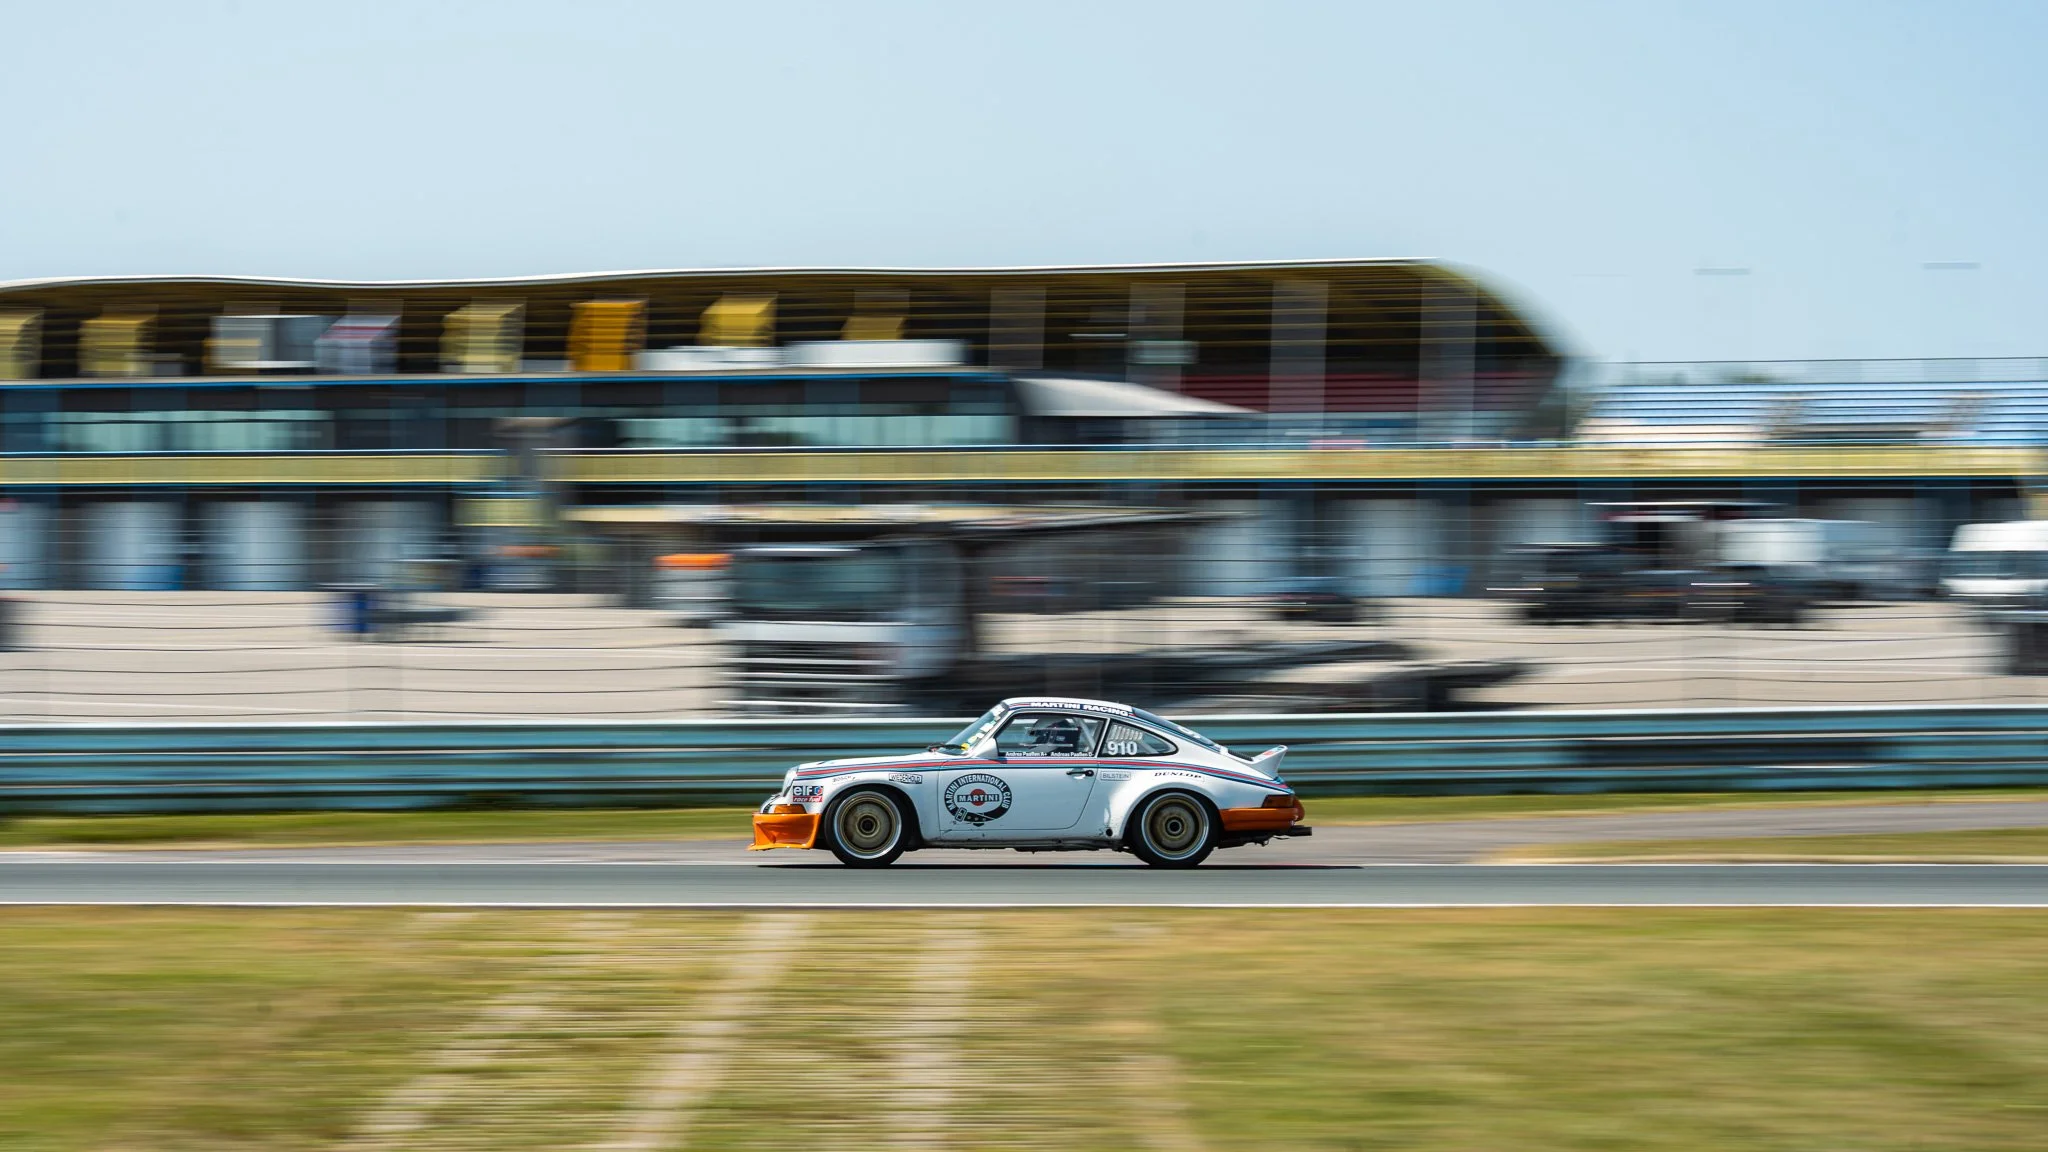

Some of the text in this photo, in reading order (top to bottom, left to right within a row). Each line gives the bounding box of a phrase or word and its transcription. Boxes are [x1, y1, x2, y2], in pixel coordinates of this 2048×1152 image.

[1083, 704, 1129, 716] RACING
[1107, 741, 1137, 755] 910
[1154, 771, 1202, 779] DUNLOP
[945, 774, 1011, 811] MARTINI INTERNATIONAL CLUB
[959, 794, 998, 802] MARTINI
